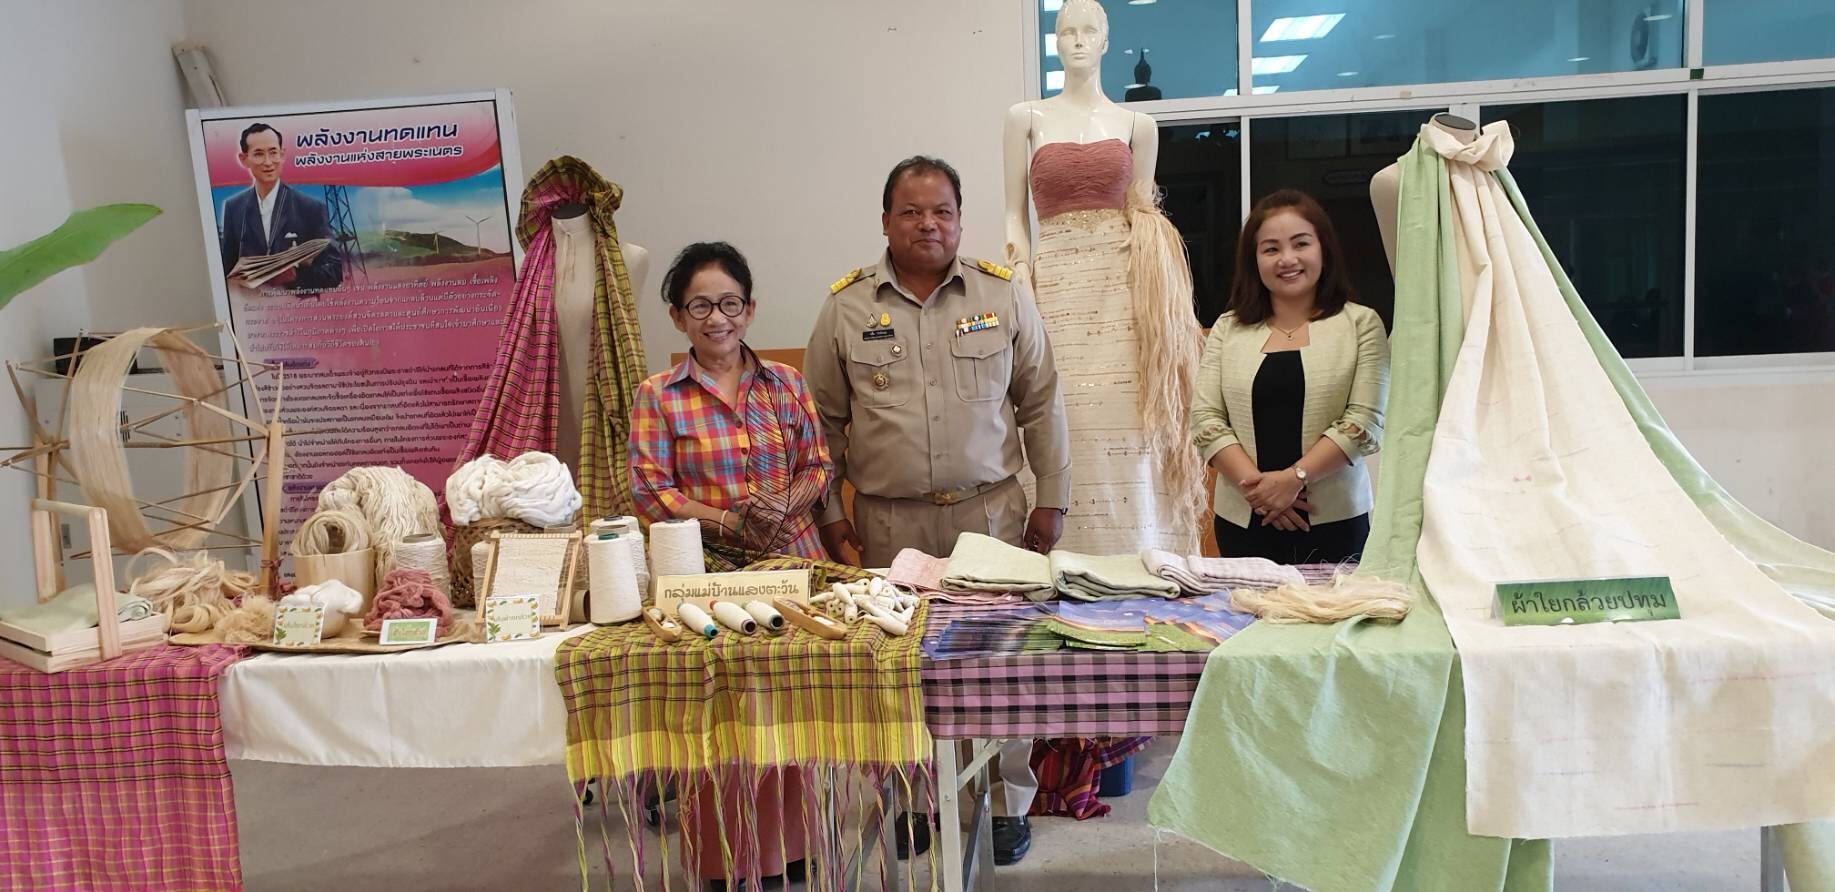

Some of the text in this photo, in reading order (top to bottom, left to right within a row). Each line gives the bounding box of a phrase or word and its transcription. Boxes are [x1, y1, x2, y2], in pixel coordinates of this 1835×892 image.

[296, 123, 458, 147] พลังงานทดแทน
[296, 145, 462, 165] พลังงานแห่งสายพระเนตร
[664, 580, 799, 602] กลุ่มแม่บ้านแสงตะวัน
[1511, 590, 1667, 617] ผ้าใยกล้วยปทุม
